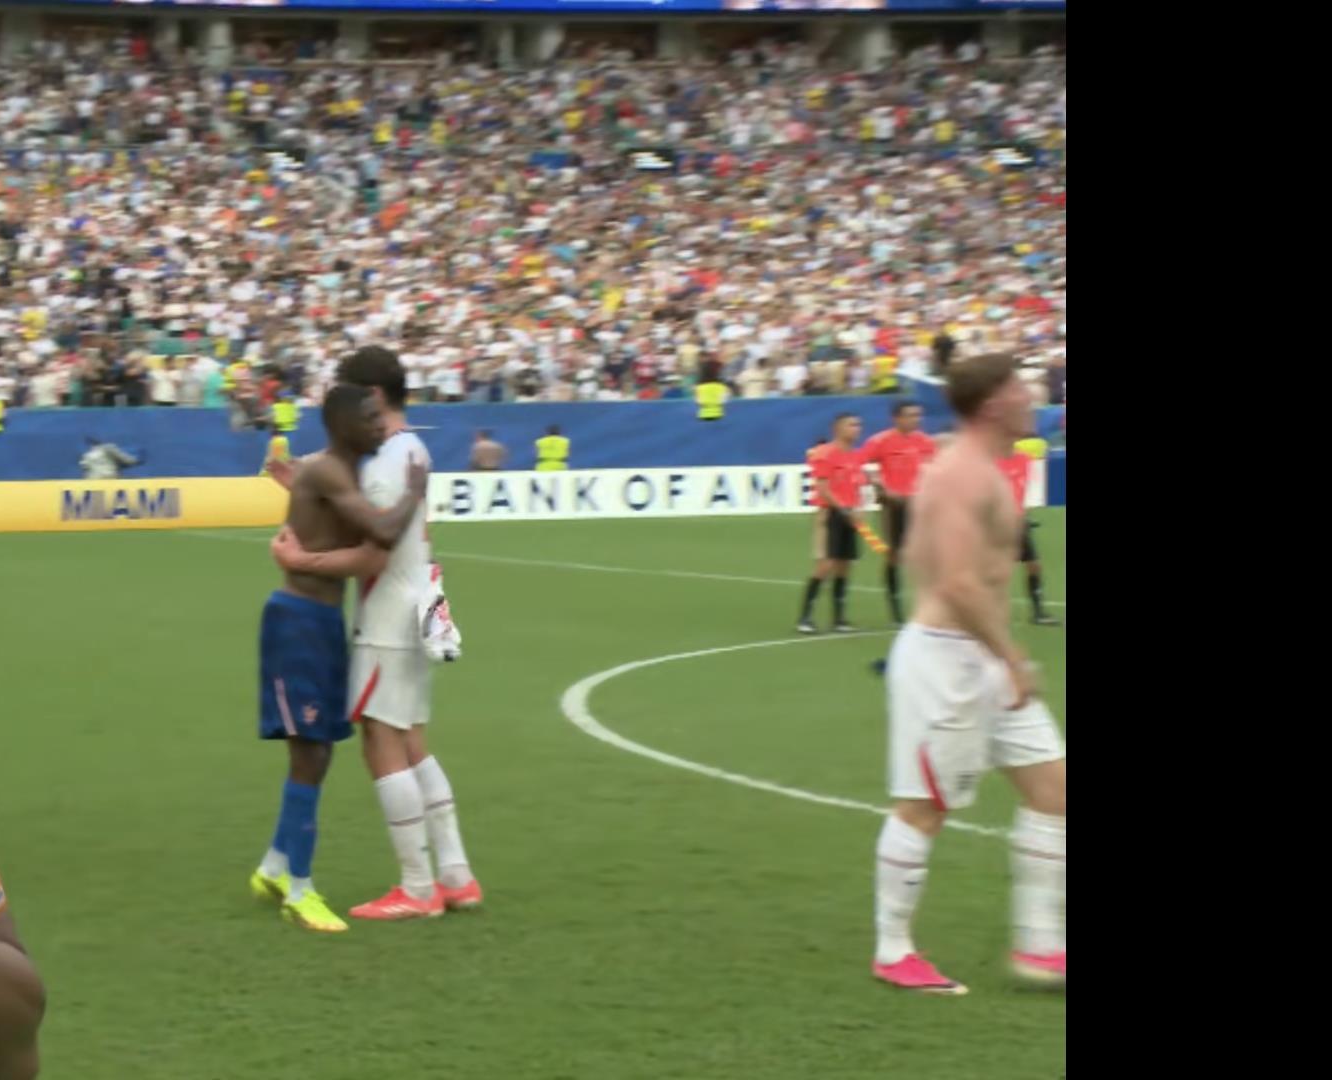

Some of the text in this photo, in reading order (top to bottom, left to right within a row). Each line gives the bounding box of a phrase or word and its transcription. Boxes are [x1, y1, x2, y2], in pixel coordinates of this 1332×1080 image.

[61, 487, 181, 521] MIAMI
[449, 476, 600, 515] BANK
[622, 474, 686, 511] OF
